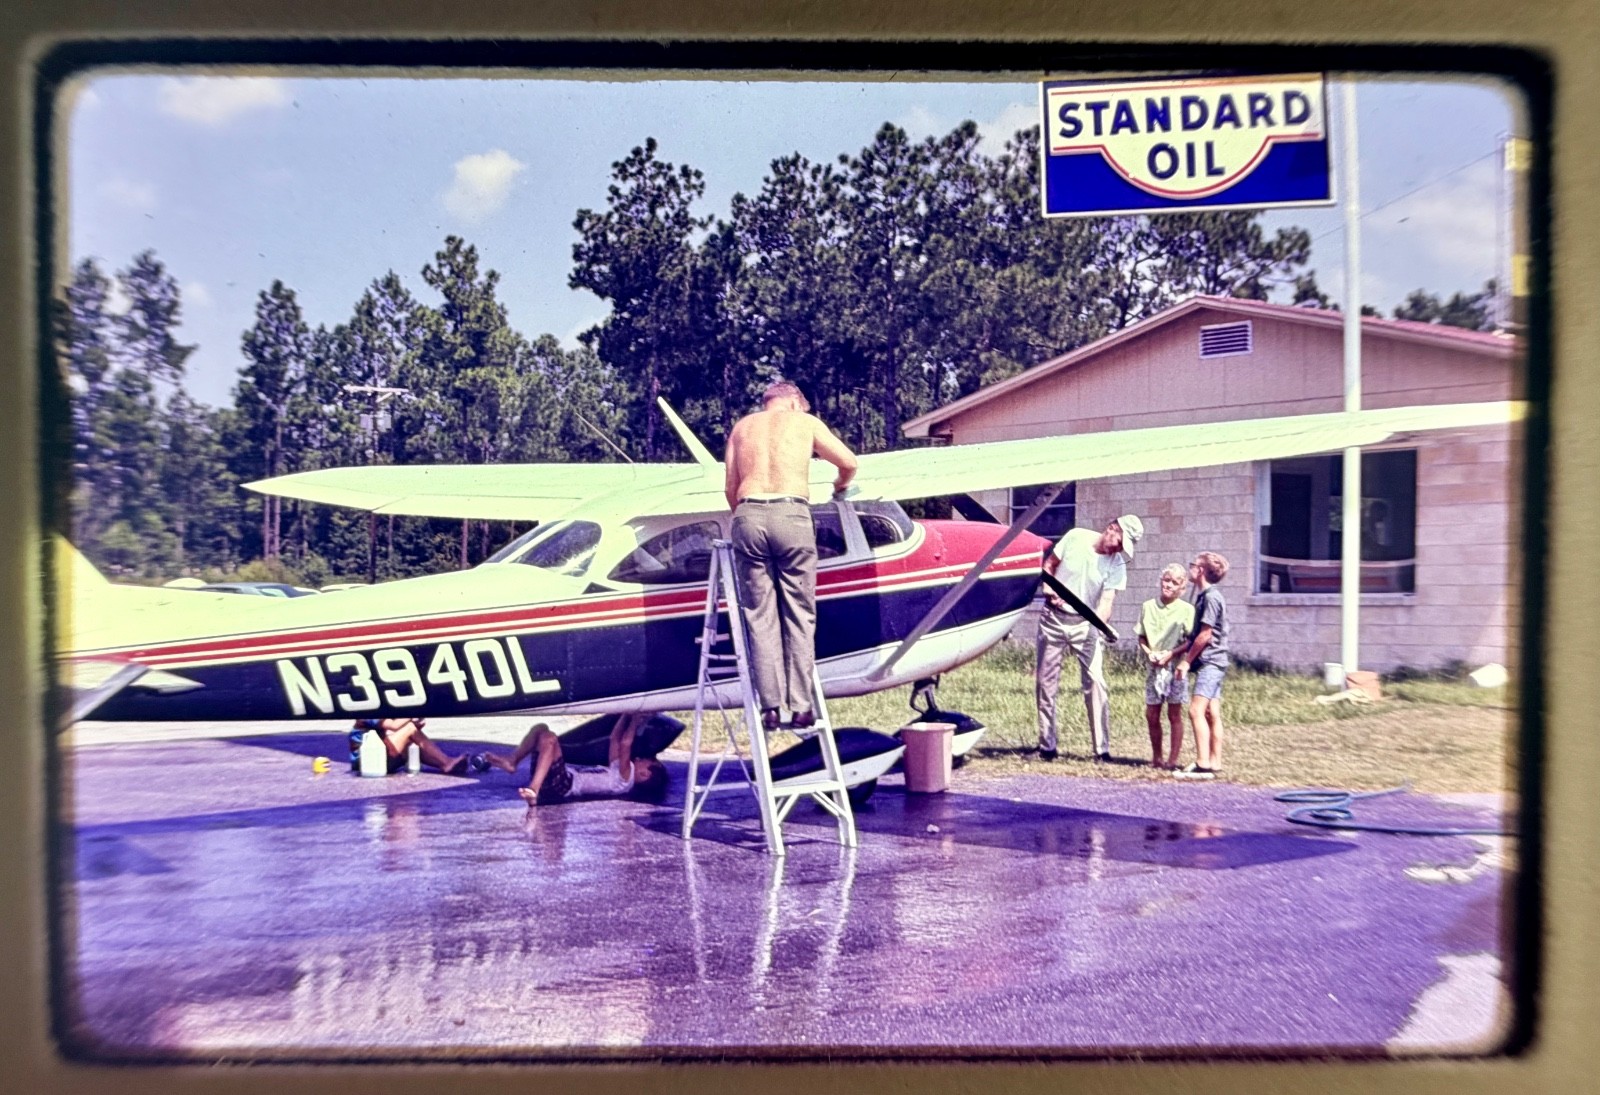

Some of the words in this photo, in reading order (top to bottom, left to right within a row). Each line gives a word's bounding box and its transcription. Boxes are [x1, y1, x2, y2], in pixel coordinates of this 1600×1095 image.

[1058, 90, 1312, 138] STANDARD
[1147, 141, 1225, 179] OIL
[277, 636, 561, 716] N3940L
